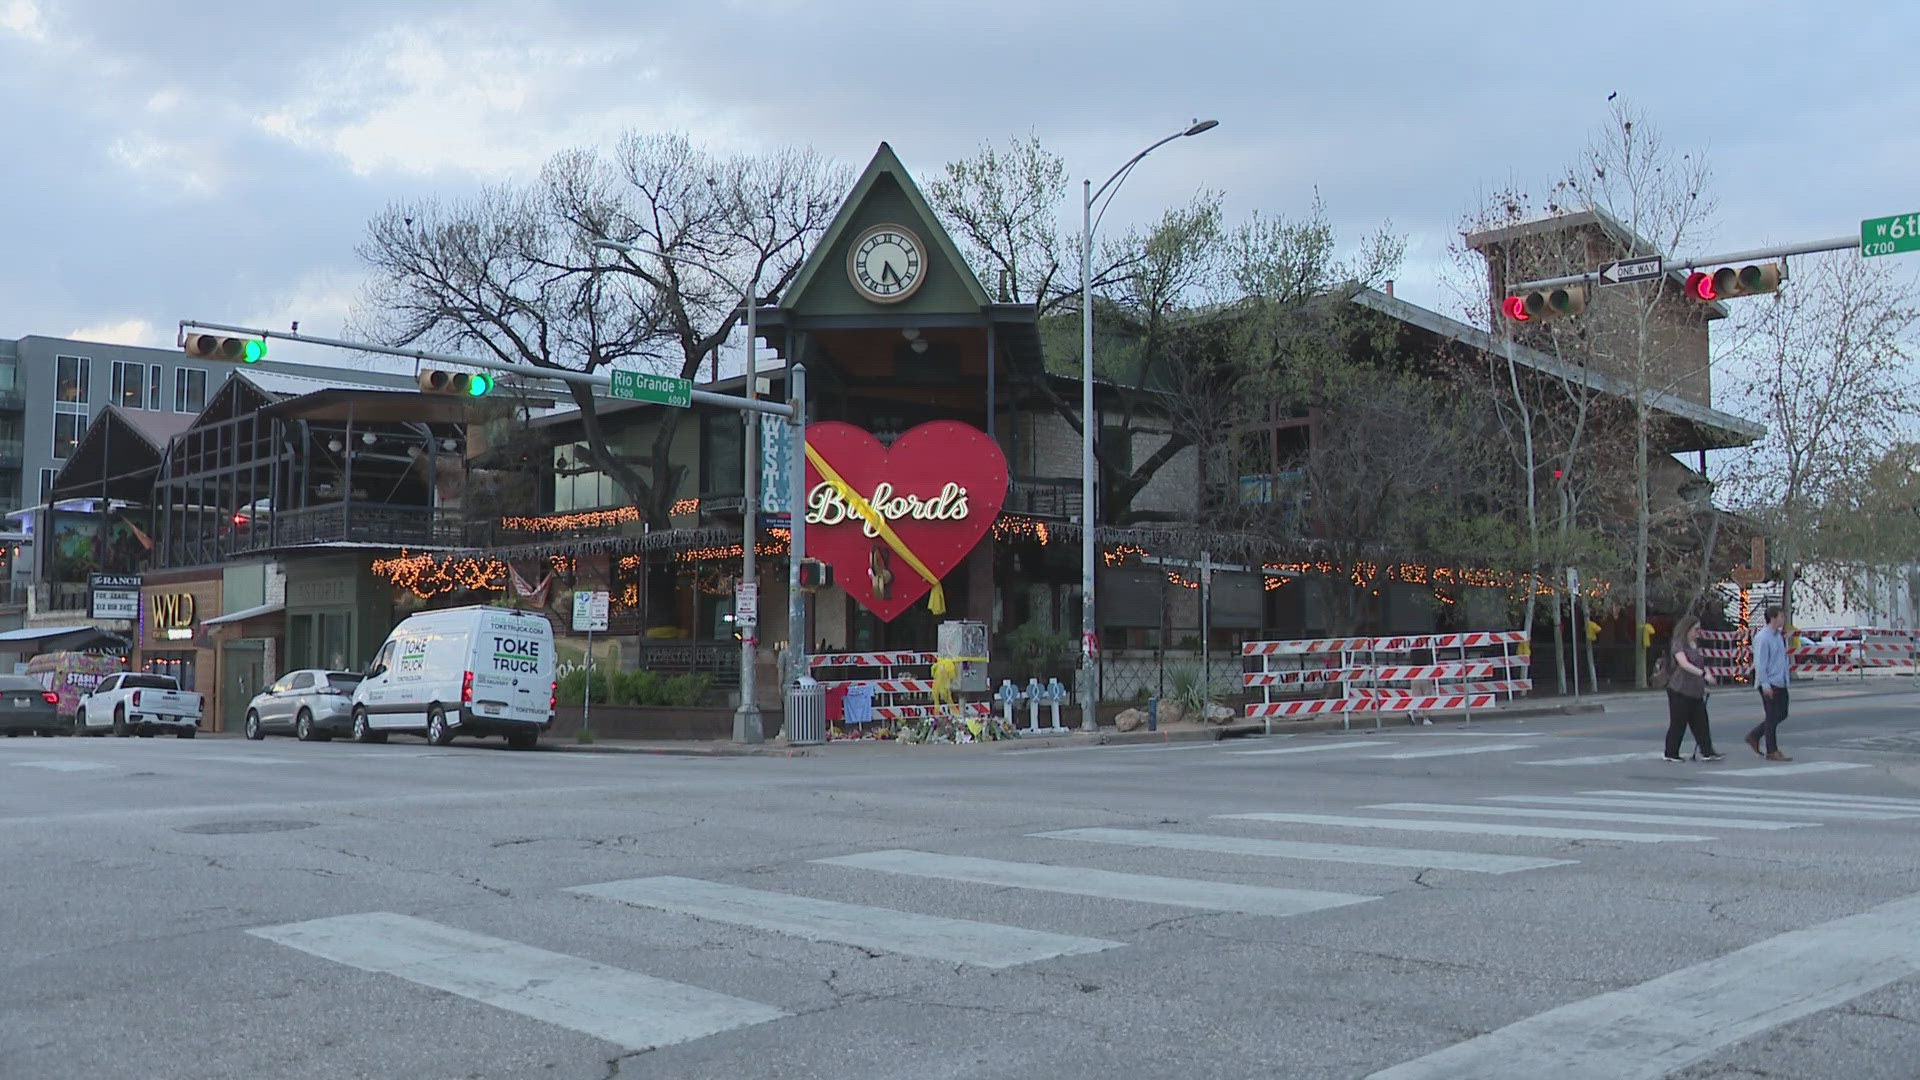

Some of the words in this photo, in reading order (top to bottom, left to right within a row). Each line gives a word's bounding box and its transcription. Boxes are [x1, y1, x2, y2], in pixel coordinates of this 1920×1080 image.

[1876, 223, 1887, 236] W
[1872, 241, 1895, 255] 700
[1617, 265, 1635, 277] ONE
[1637, 262, 1656, 274] WAY
[614, 371, 633, 387] Rio
[636, 374, 675, 393] Grande
[678, 381, 688, 390] ST
[619, 388, 634, 398] 500
[667, 395, 681, 404] 600
[806, 480, 969, 538] Buford's
[103, 576, 141, 586] RANCH
[151, 593, 193, 628] WYLD
[491, 623, 544, 635] TOKETRUCK.COM
[404, 638, 428, 654] TOKE
[493, 637, 539, 657] TOKE
[400, 659, 424, 673] TRUCK
[493, 657, 538, 675] TRUCK
[67, 672, 96, 685] STASH
